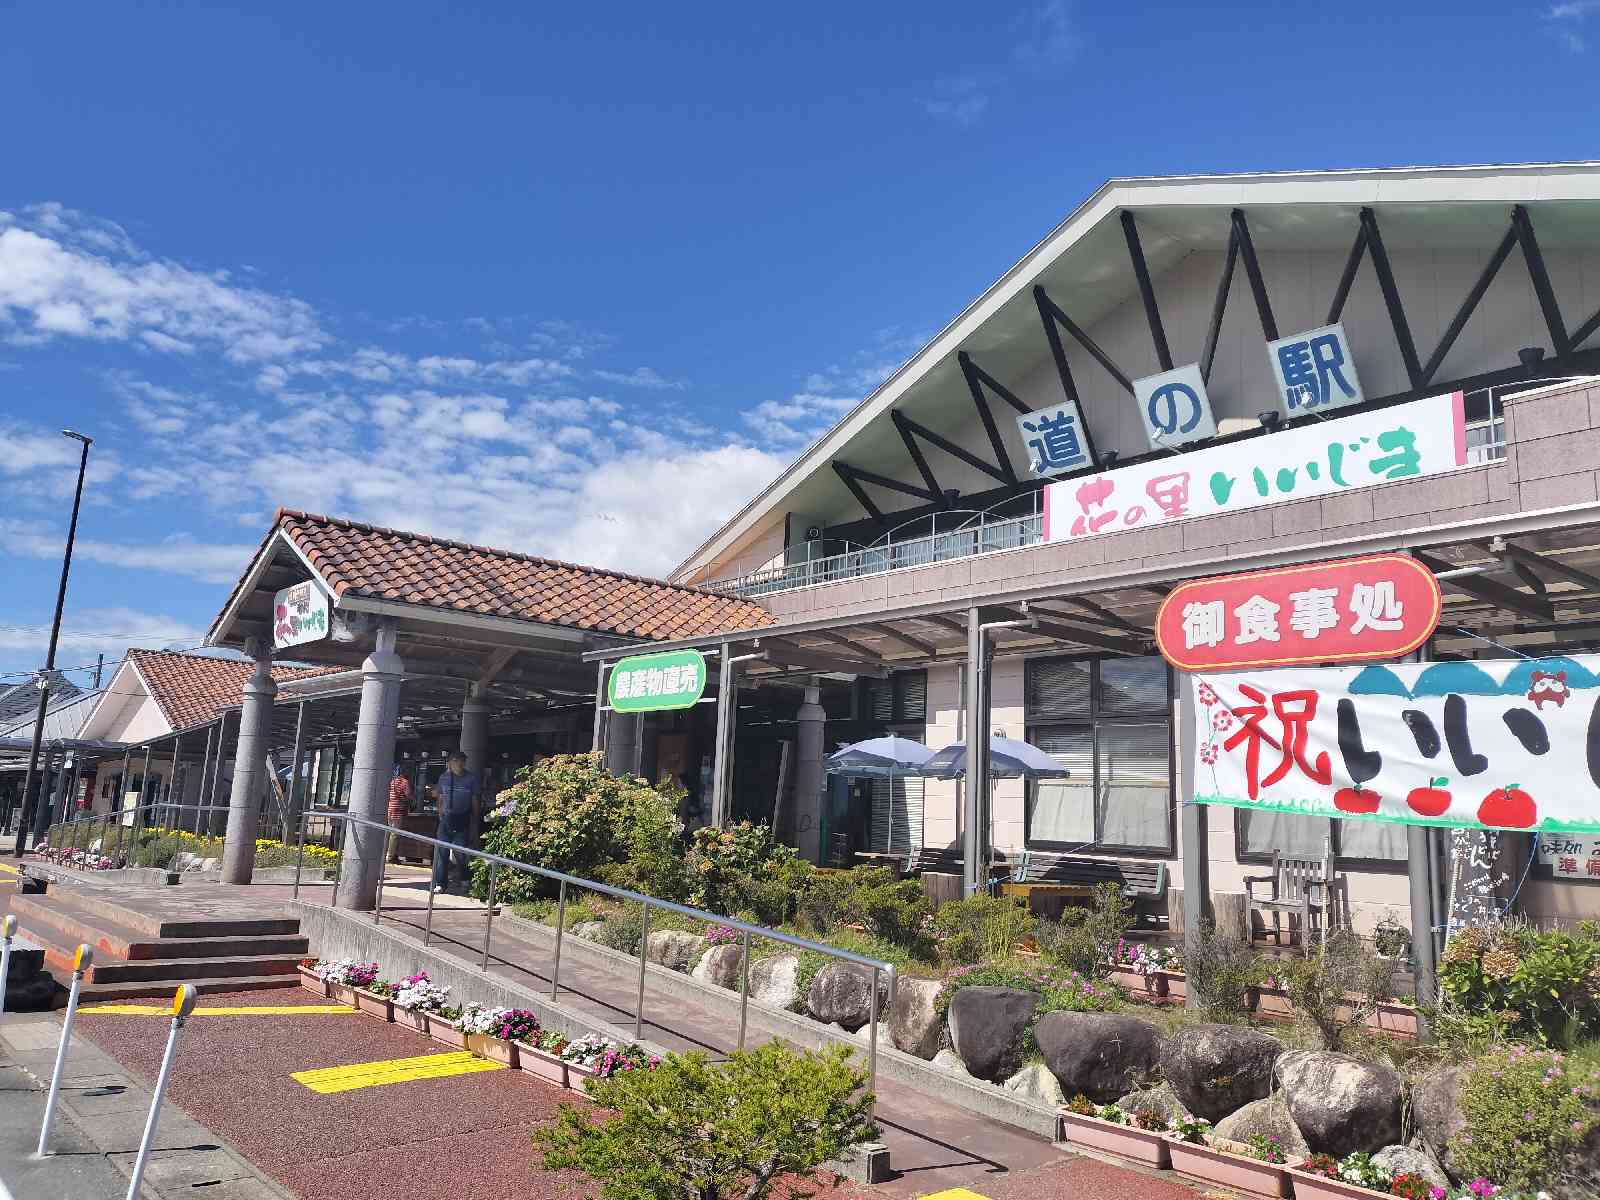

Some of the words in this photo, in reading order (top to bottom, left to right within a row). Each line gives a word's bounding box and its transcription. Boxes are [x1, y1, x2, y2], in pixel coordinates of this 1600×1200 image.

[1022, 333, 1357, 474] 道の駅
[1209, 425, 1422, 506] いいじま
[1181, 581, 1404, 649] 御食事処
[1223, 683, 1332, 800] 祝
[1336, 693, 1600, 790] いい
